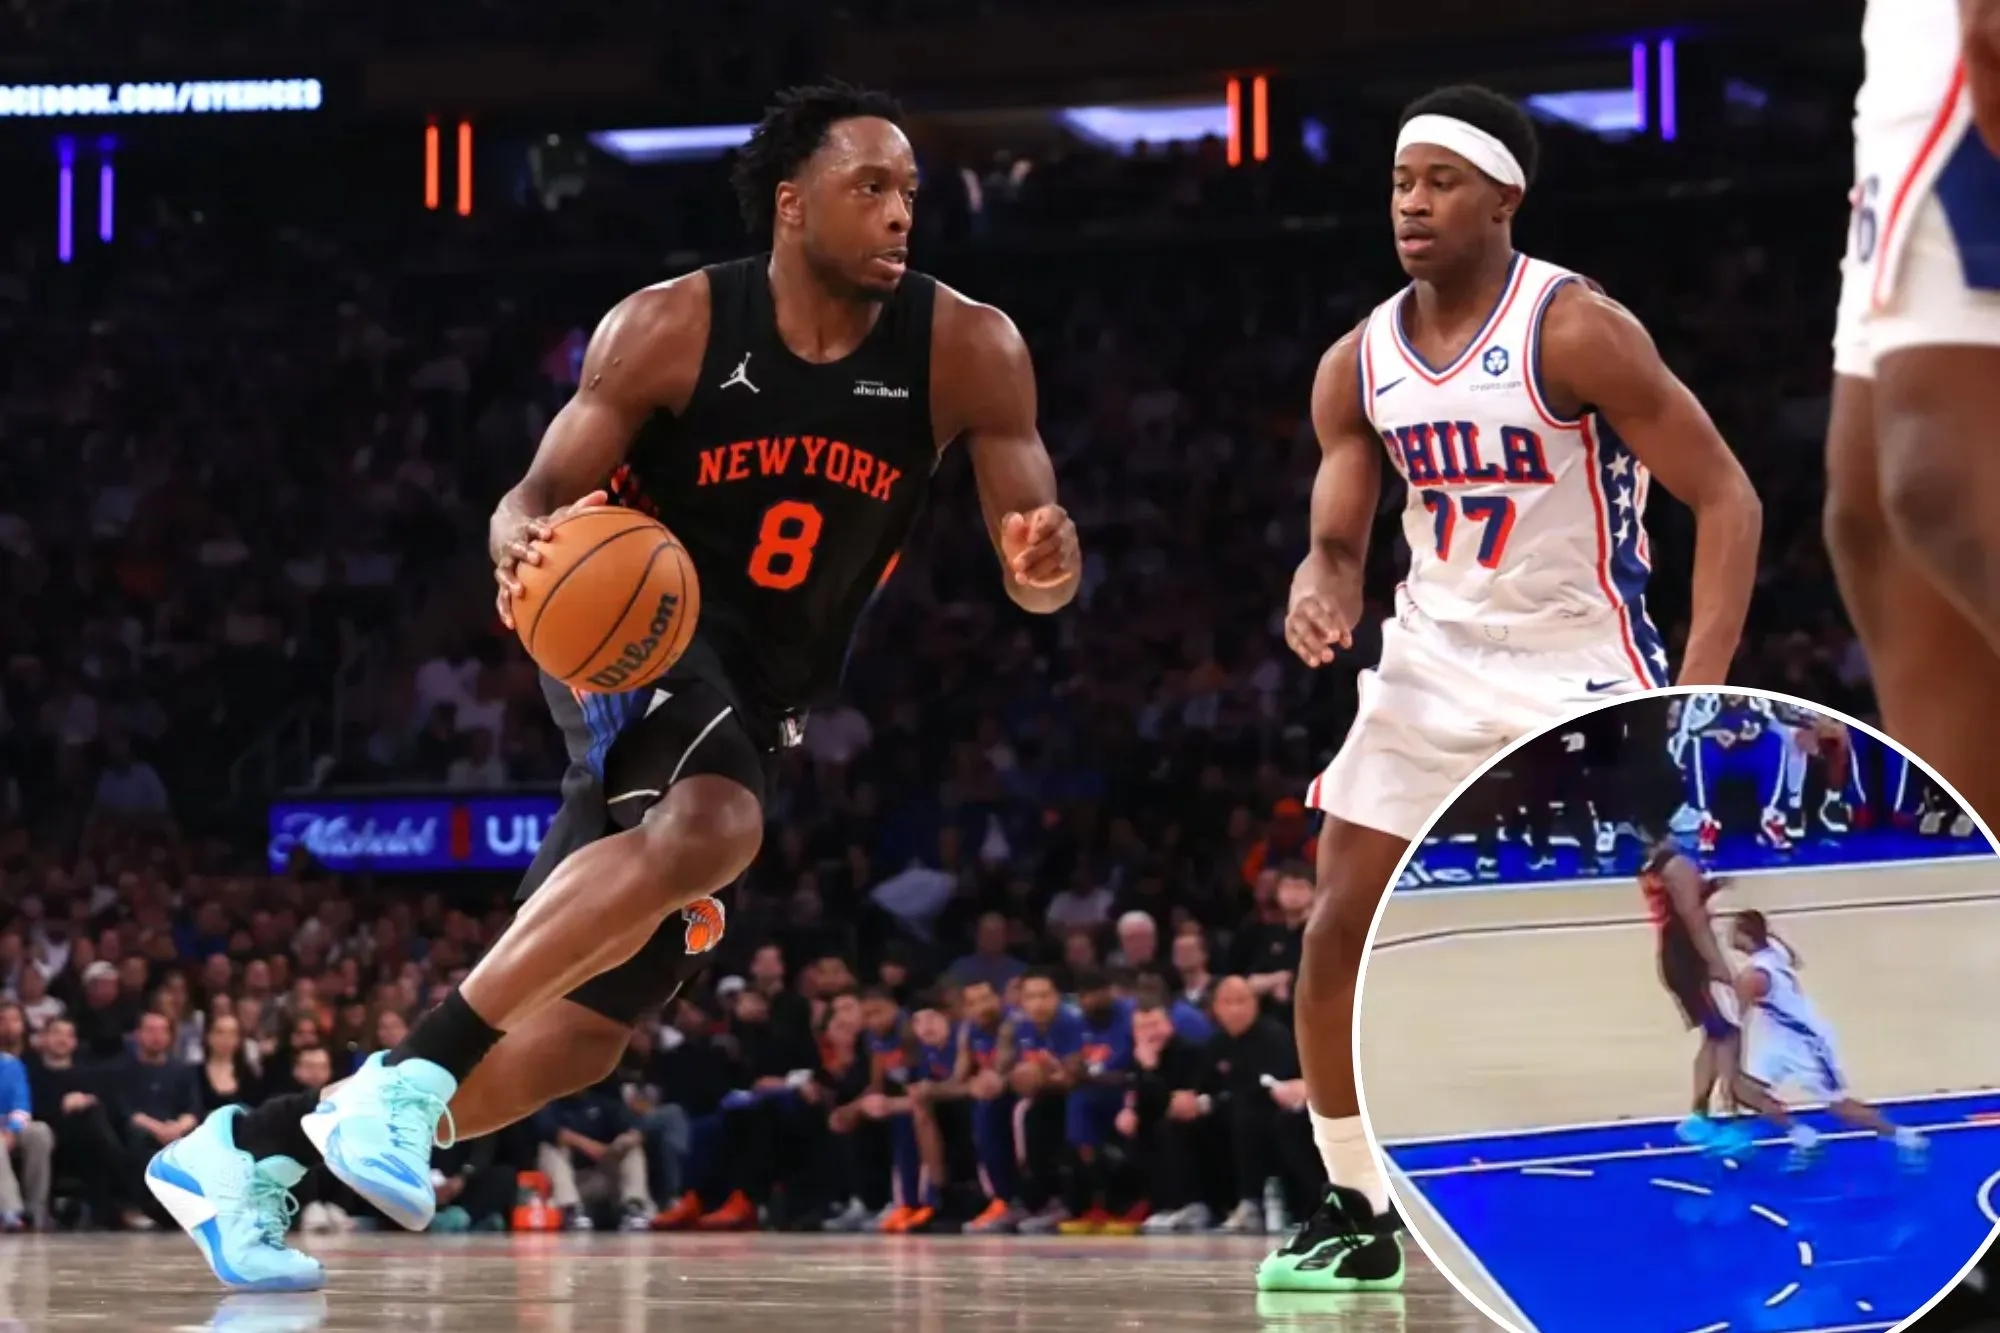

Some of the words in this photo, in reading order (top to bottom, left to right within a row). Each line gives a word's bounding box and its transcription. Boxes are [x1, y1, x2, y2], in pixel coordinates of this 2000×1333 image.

[697, 436, 796, 486] NEW
[801, 435, 902, 502] YORK
[747, 499, 824, 591] 8
[1420, 488, 1517, 569] 77
[585, 592, 679, 689] Wilson
[486, 814, 559, 855] UL
